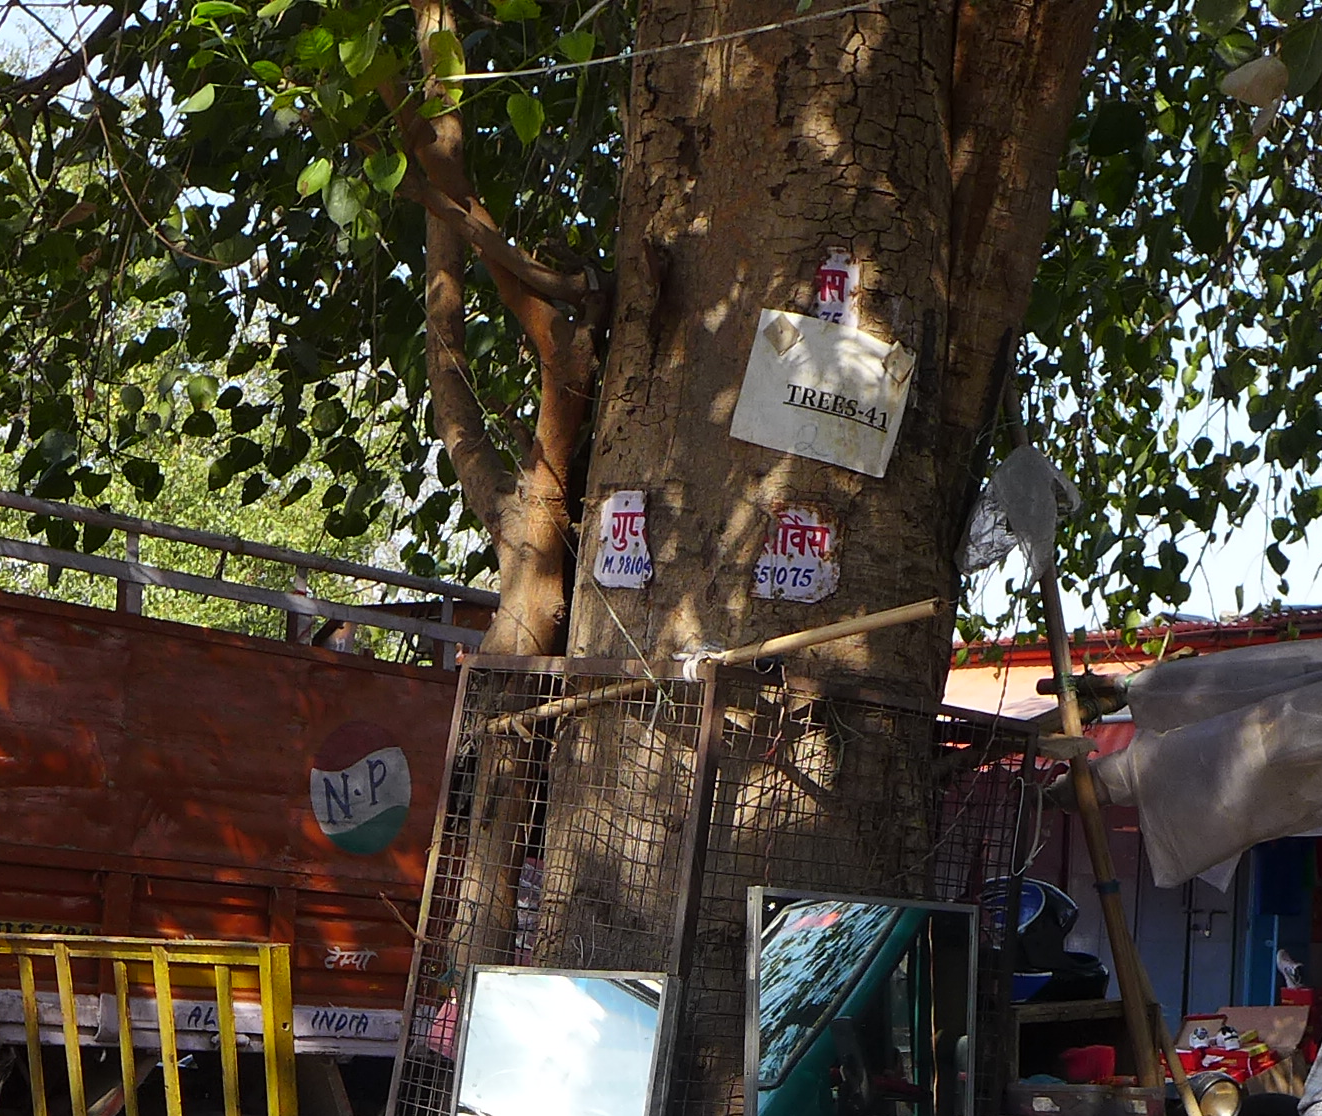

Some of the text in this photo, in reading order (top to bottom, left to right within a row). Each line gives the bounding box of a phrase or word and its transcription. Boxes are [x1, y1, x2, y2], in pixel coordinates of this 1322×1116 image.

[786, 383, 889, 430] TREES-41
[754, 565, 816, 588] 51075
[310, 1009, 369, 1034] INDIA
